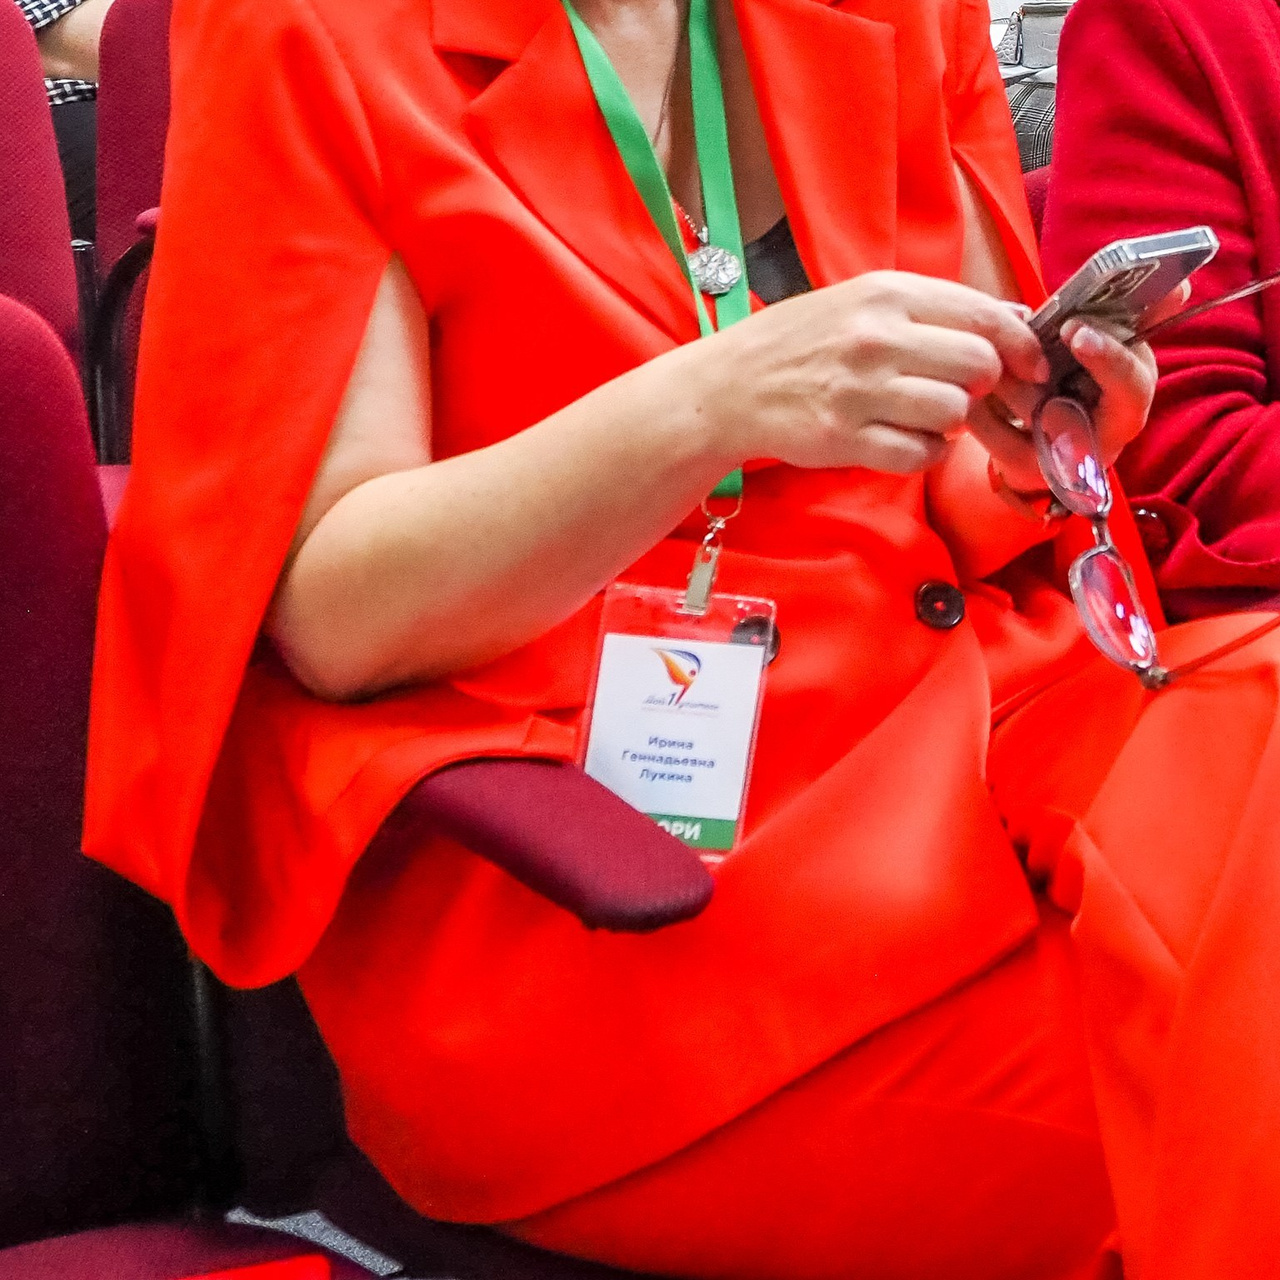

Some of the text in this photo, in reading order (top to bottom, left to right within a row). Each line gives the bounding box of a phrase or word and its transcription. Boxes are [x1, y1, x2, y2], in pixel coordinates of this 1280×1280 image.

[648, 736, 694, 750] Ирина
[622, 750, 715, 768] Геннадьевна
[657, 819, 702, 841] РИ
